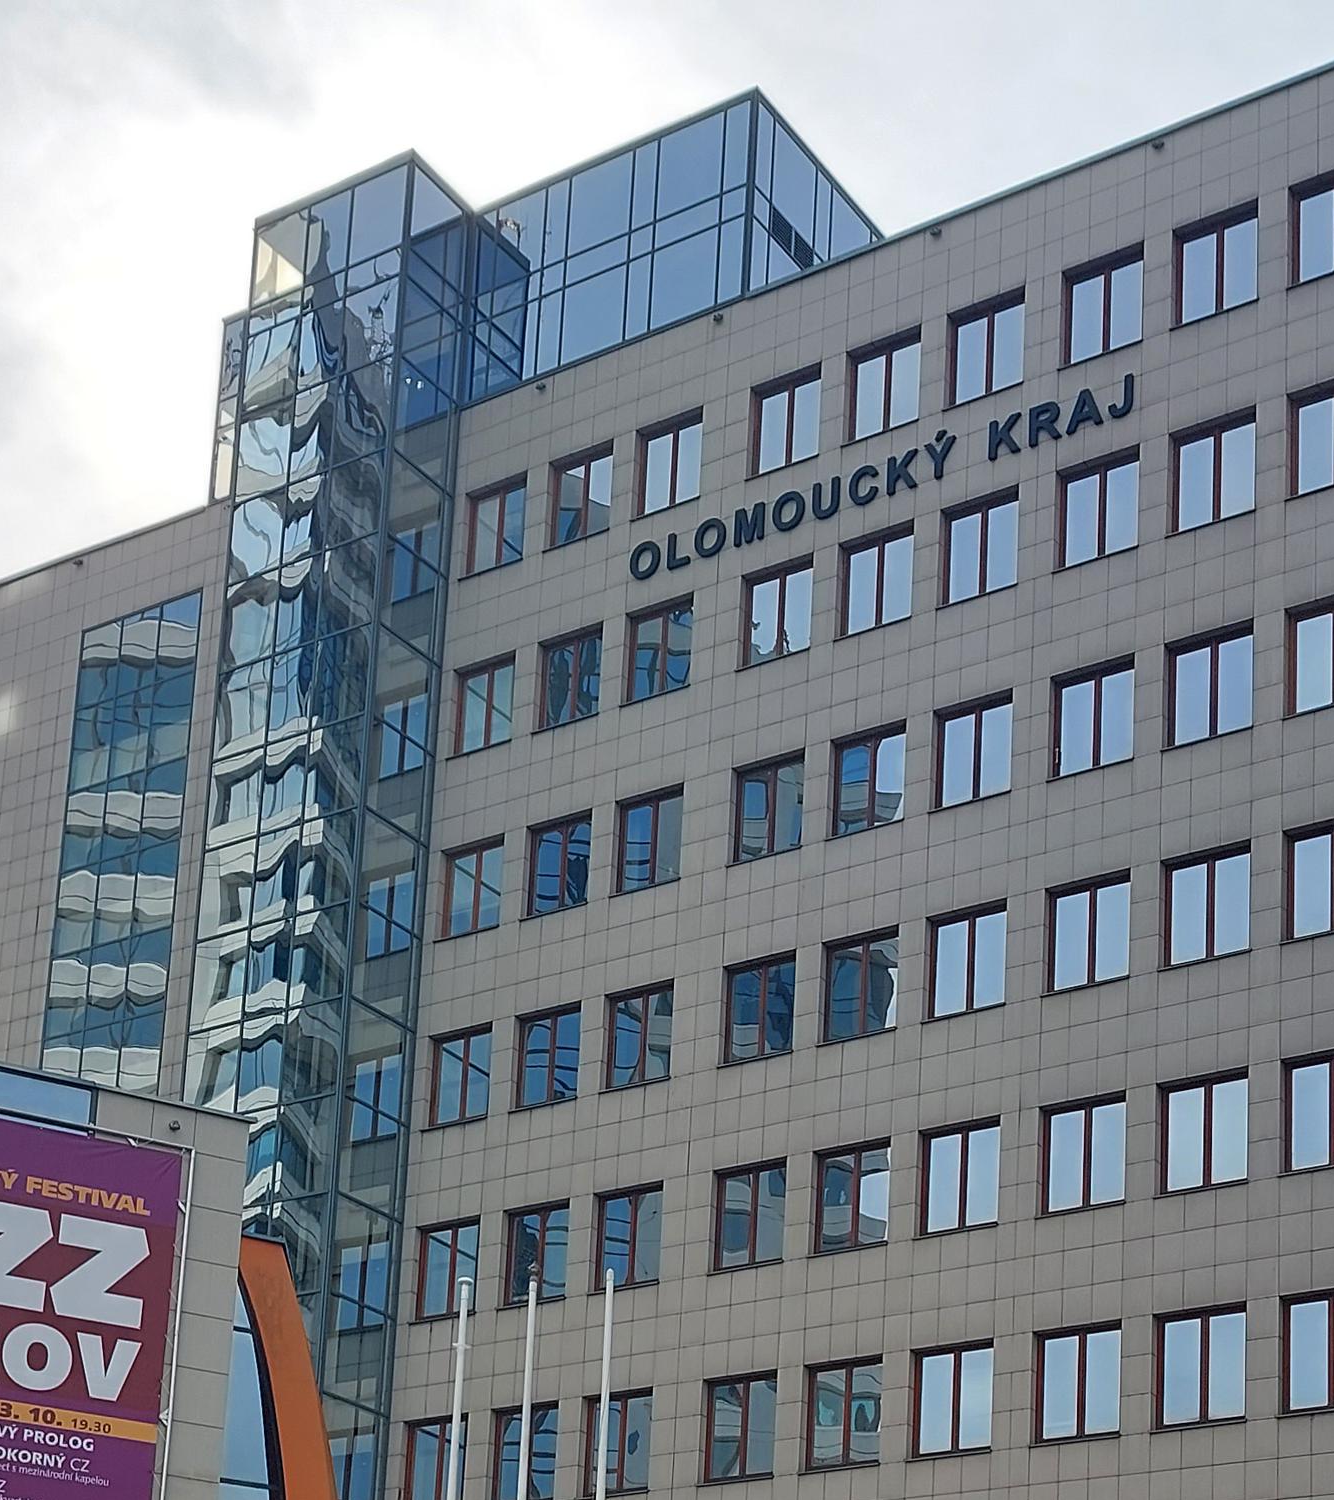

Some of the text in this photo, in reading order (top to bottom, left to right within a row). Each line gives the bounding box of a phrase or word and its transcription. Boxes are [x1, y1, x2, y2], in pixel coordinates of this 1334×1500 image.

[630, 373, 1135, 580] OLOMOUCKÝ KRAJ
[25, 1175, 151, 1216] FESTIVAL
[29, 1408, 62, 1426] 10.
[70, 1418, 111, 1433] 19.30
[23, 1429, 95, 1451] PROLOG
[19, 1465, 73, 1481] mezinárodní
[75, 1472, 109, 1487] kapelou
[70, 1458, 90, 1472] CZ
